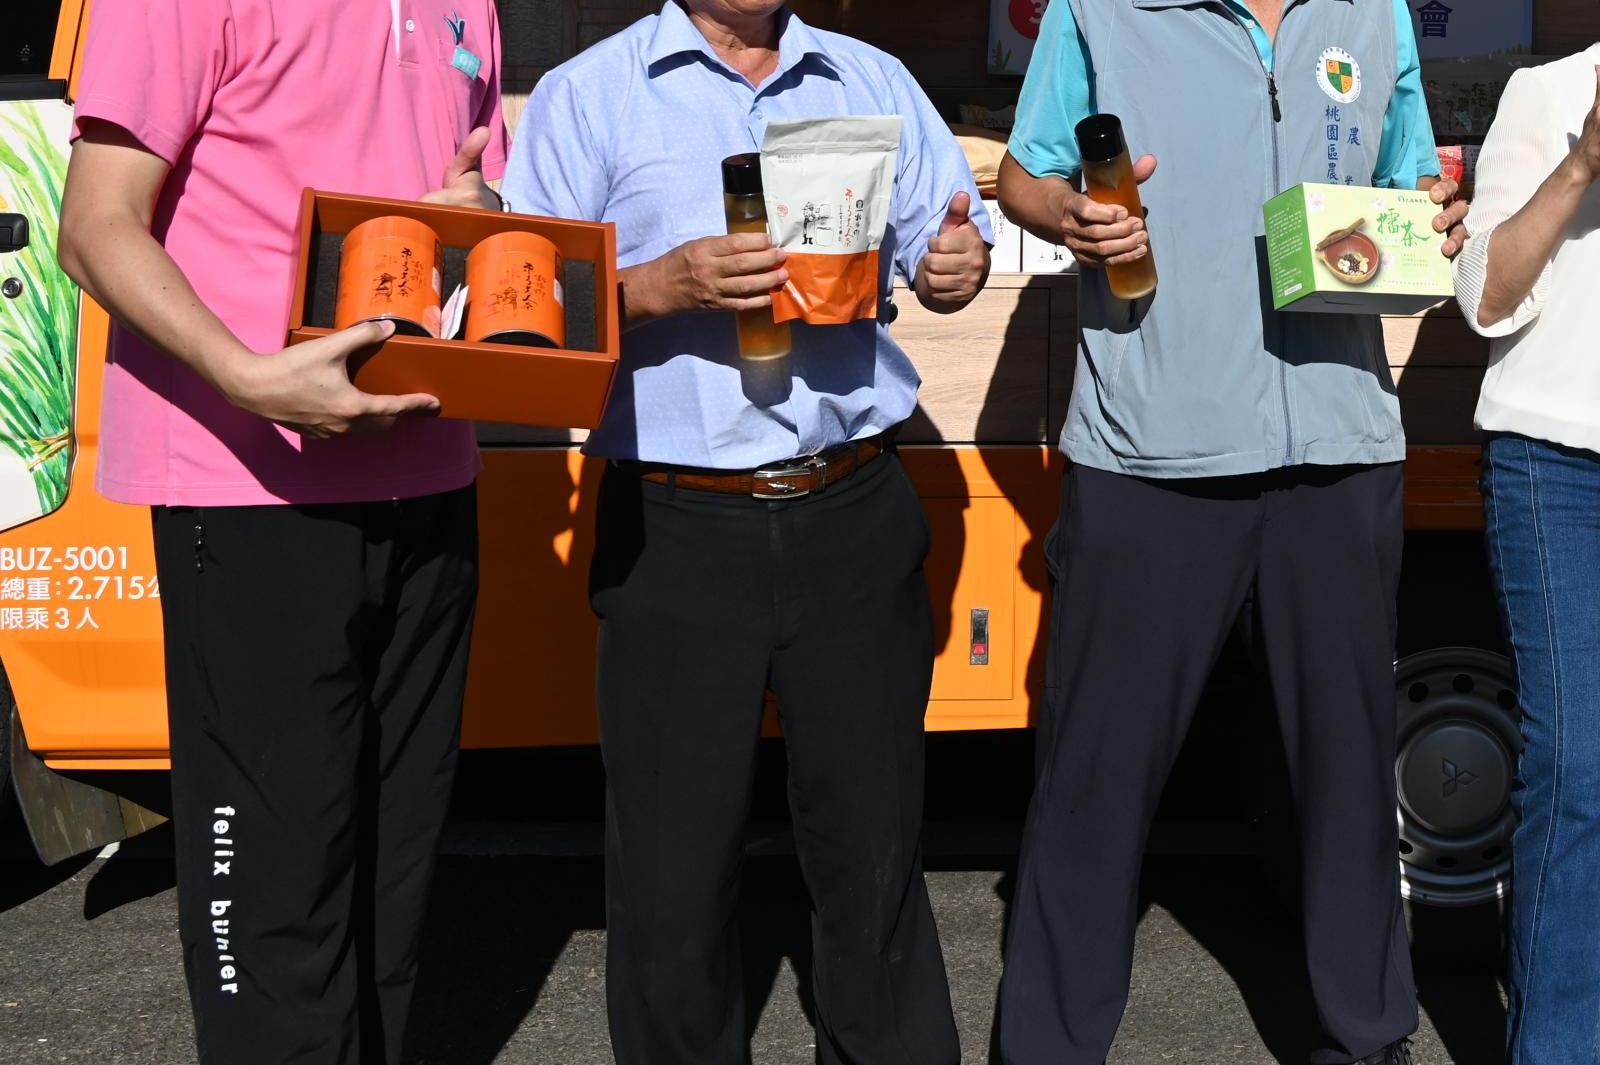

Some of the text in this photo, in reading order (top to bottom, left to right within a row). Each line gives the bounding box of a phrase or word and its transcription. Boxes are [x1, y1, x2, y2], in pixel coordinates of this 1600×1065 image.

[1325, 105, 1341, 185] 桃園區農
[1376, 208, 1430, 247] 擂茶
[0, 546, 128, 571] BUZ-5001
[213, 806, 236, 876] felix
